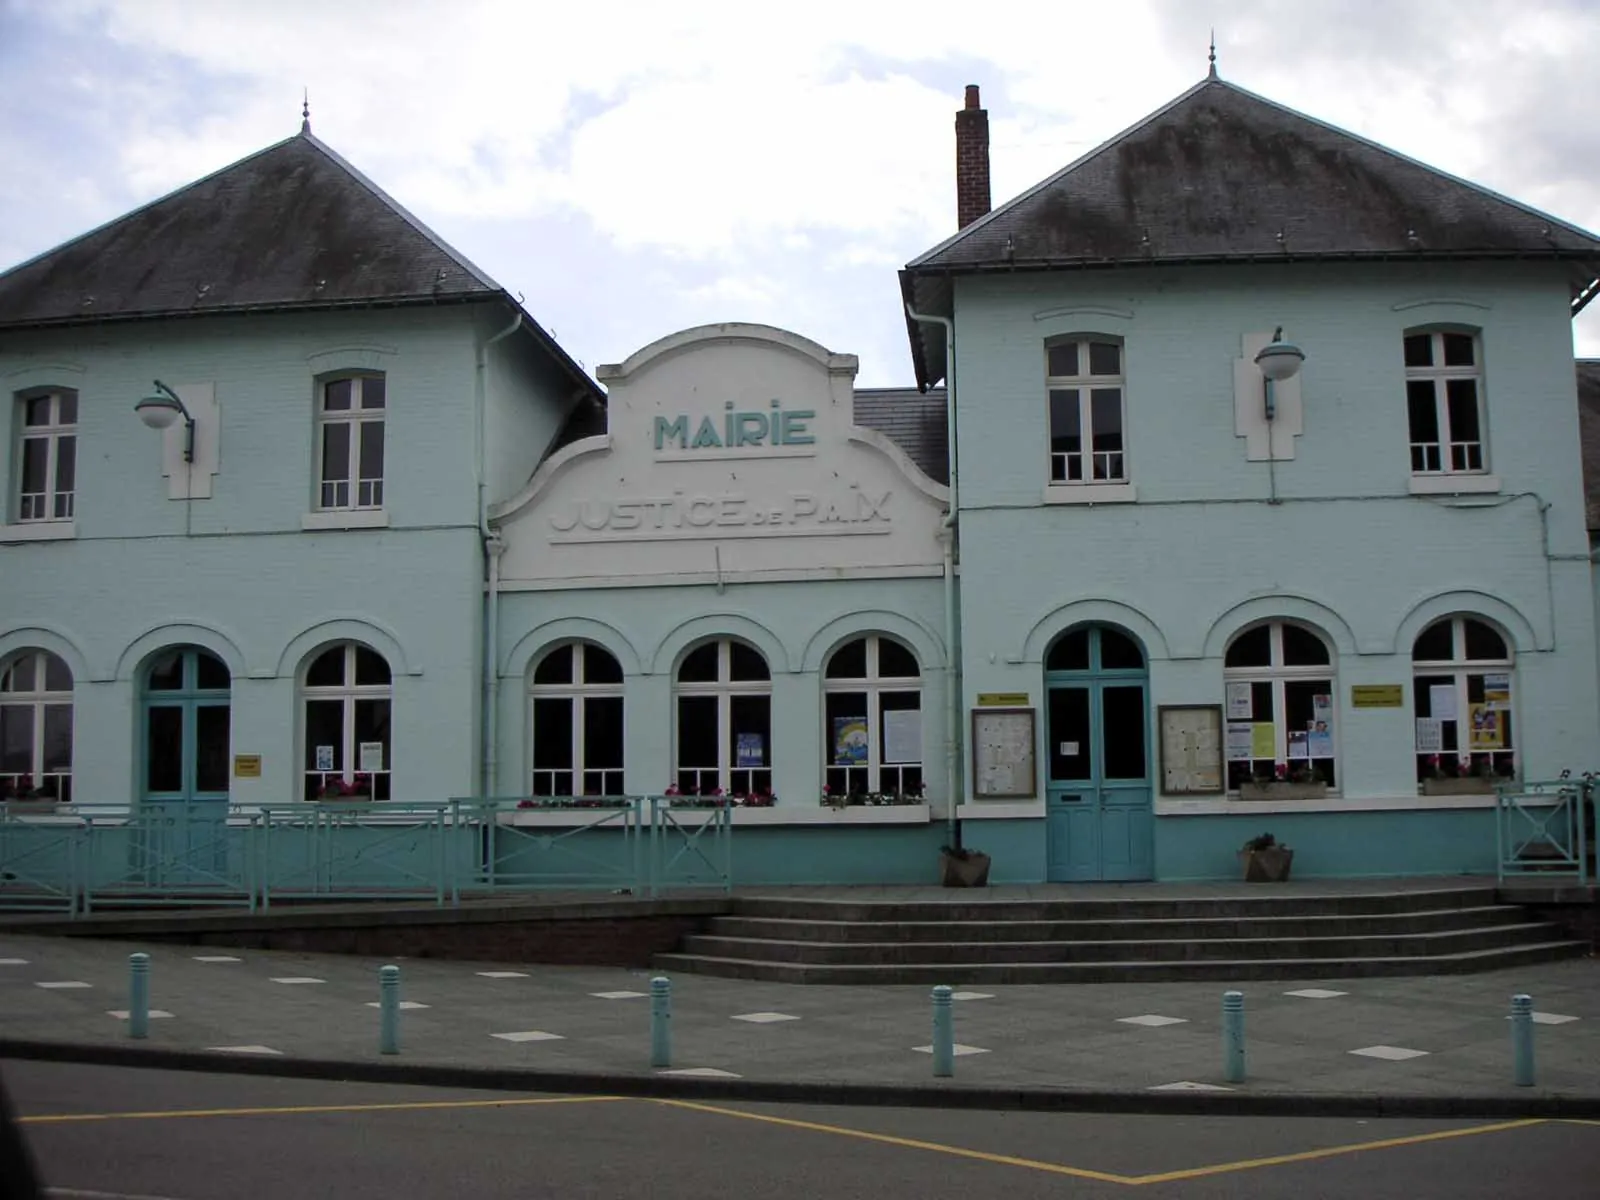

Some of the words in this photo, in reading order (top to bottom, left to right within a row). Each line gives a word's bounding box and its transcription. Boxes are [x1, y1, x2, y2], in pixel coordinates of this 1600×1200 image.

[654, 399, 815, 450] MAIRIE
[550, 491, 747, 531] JUSTICE
[751, 511, 783, 526] DE
[788, 484, 892, 526] PAIX
